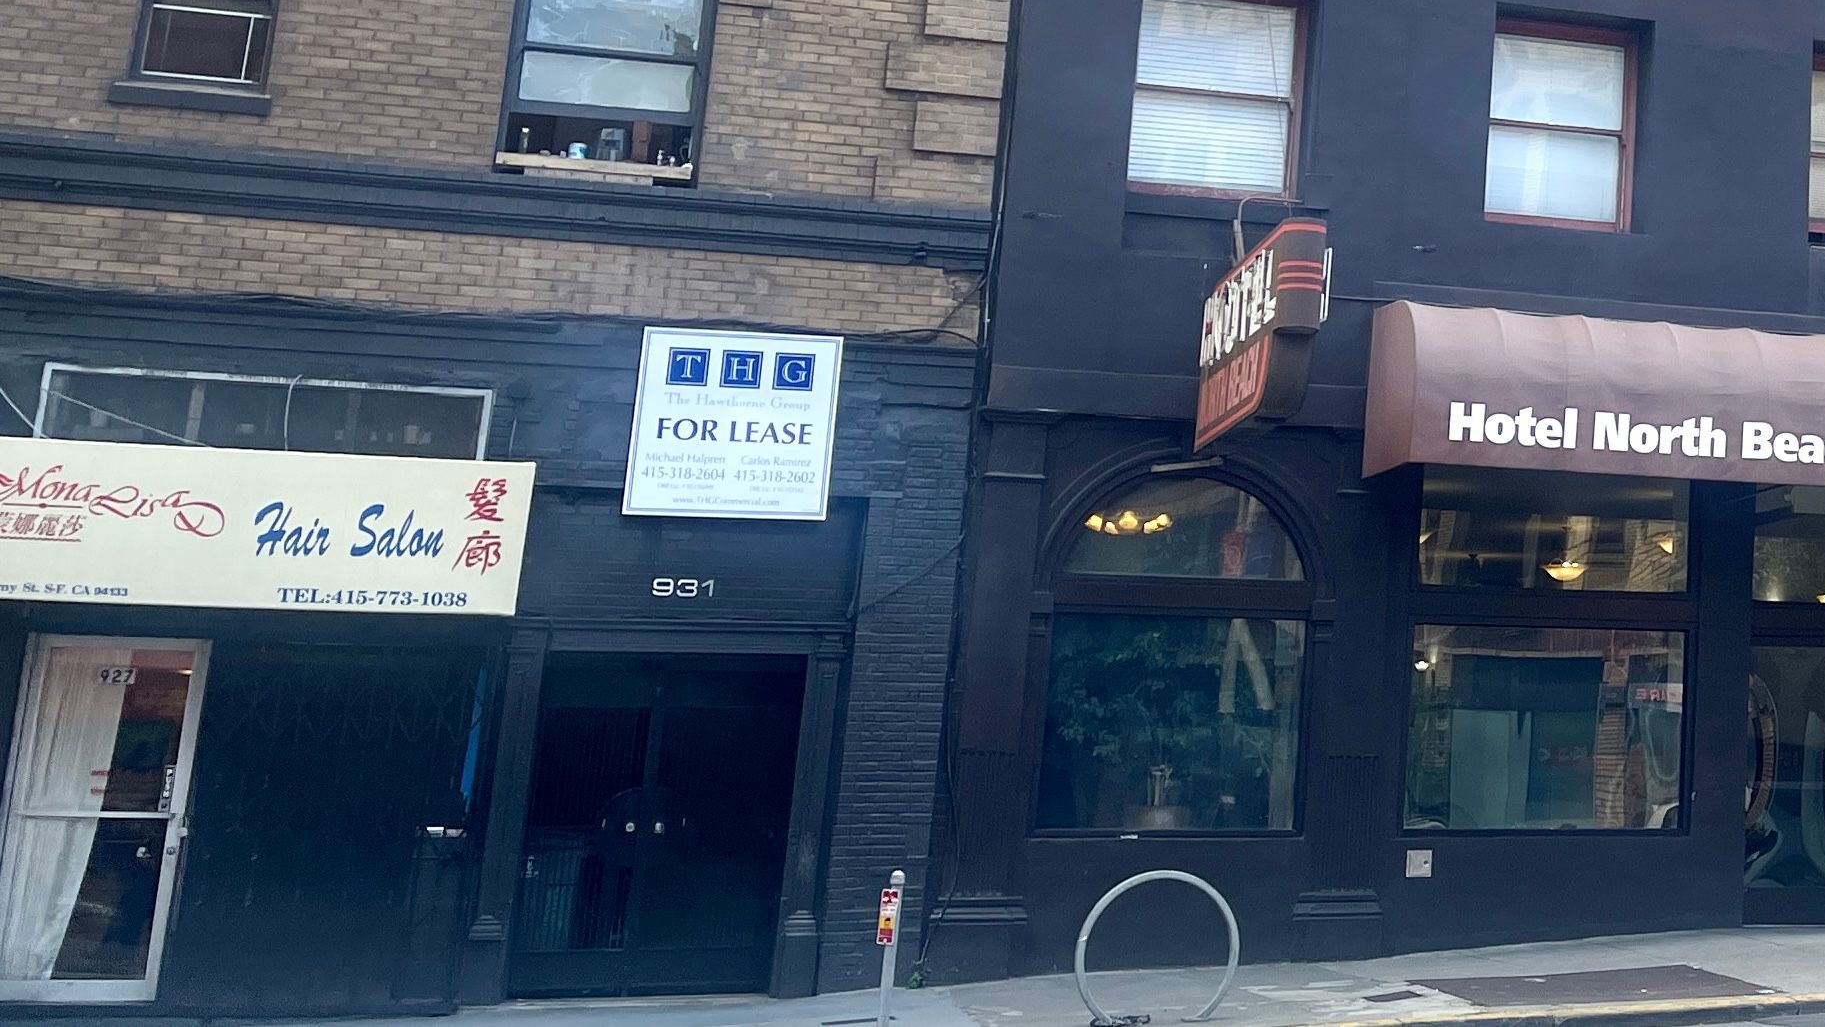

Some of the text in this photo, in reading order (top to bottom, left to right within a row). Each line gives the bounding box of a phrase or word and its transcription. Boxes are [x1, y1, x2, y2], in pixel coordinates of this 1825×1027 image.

[1200, 248, 1277, 367] HOTEL
[664, 392, 811, 411] The Hawthorne Group
[656, 418, 814, 445] FOR LEASE
[1448, 400, 1578, 450] Hotel
[1592, 411, 1727, 459] North
[645, 452, 684, 464] Michael
[741, 455, 811, 468] Carlos Ramirez
[641, 466, 725, 480] 415-318-2604
[733, 469, 816, 484] 415-318-2602
[0, 465, 225, 537] Mona Lisa
[254, 501, 444, 558] Hair Salon
[72, 585, 91, 596] CA
[94, 587, 129, 597] 94133
[277, 587, 468, 607] TEL:415-773-1038
[652, 578, 715, 597] 931
[100, 669, 135, 683] 927
